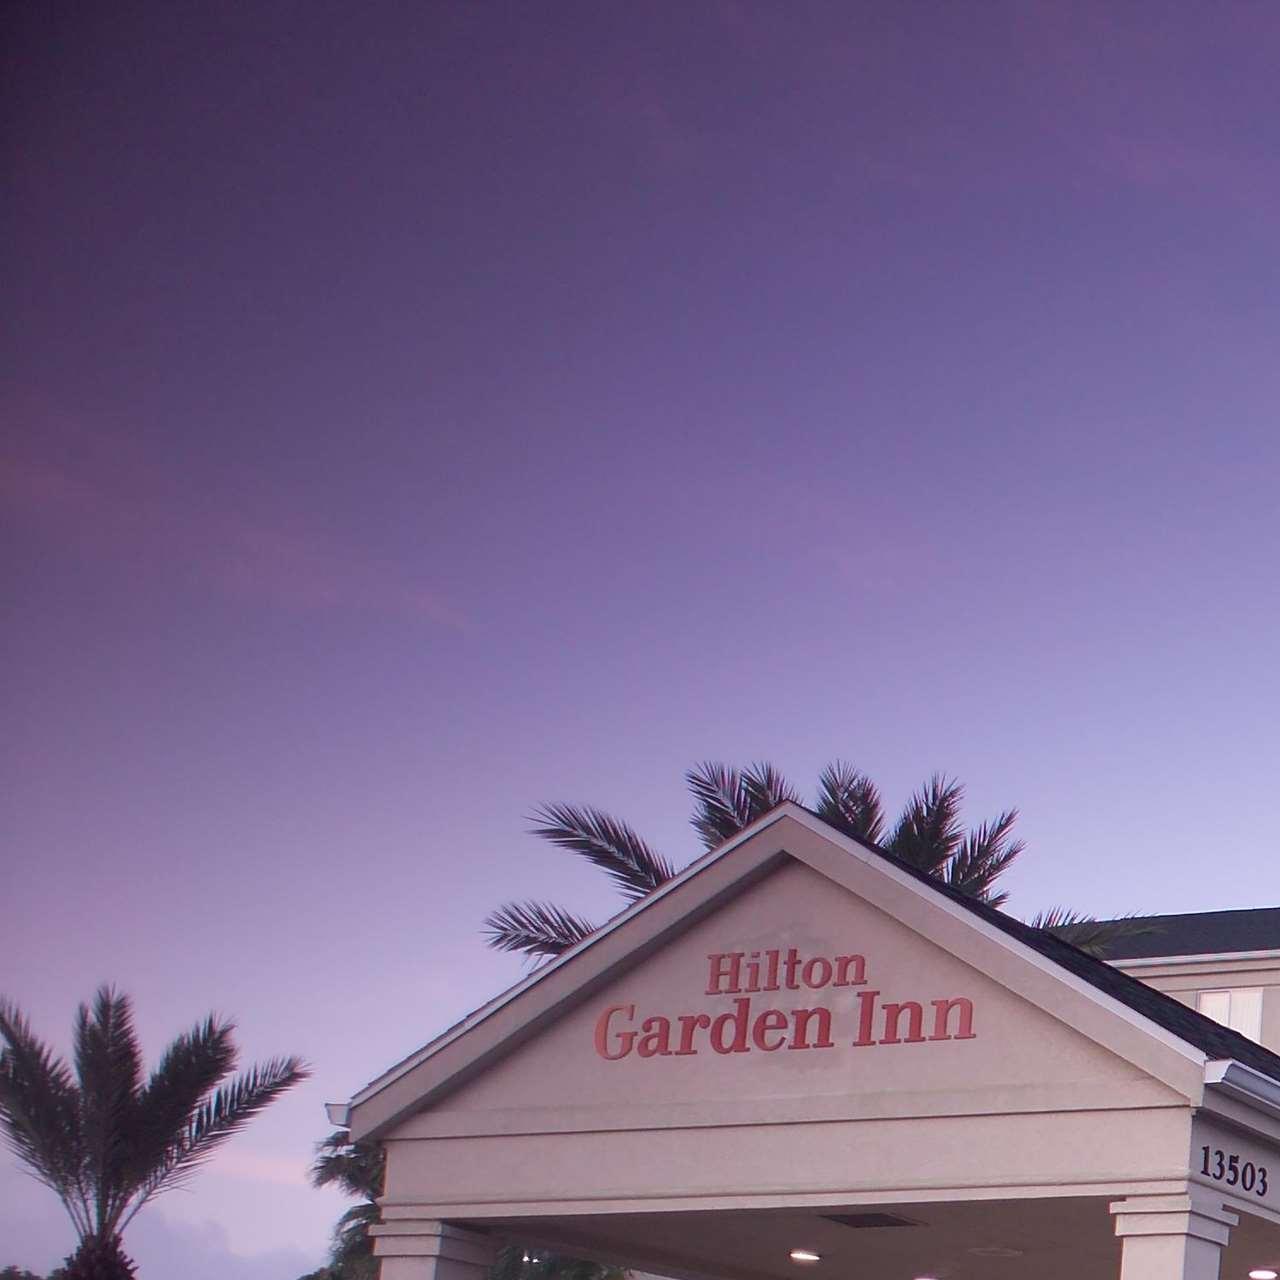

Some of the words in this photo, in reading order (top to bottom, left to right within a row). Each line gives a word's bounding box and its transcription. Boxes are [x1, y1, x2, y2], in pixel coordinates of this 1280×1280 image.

[704, 948, 867, 995] Hilton
[594, 998, 834, 1061] Garden
[853, 990, 977, 1048] Inn
[1200, 1144, 1268, 1197] 13503
